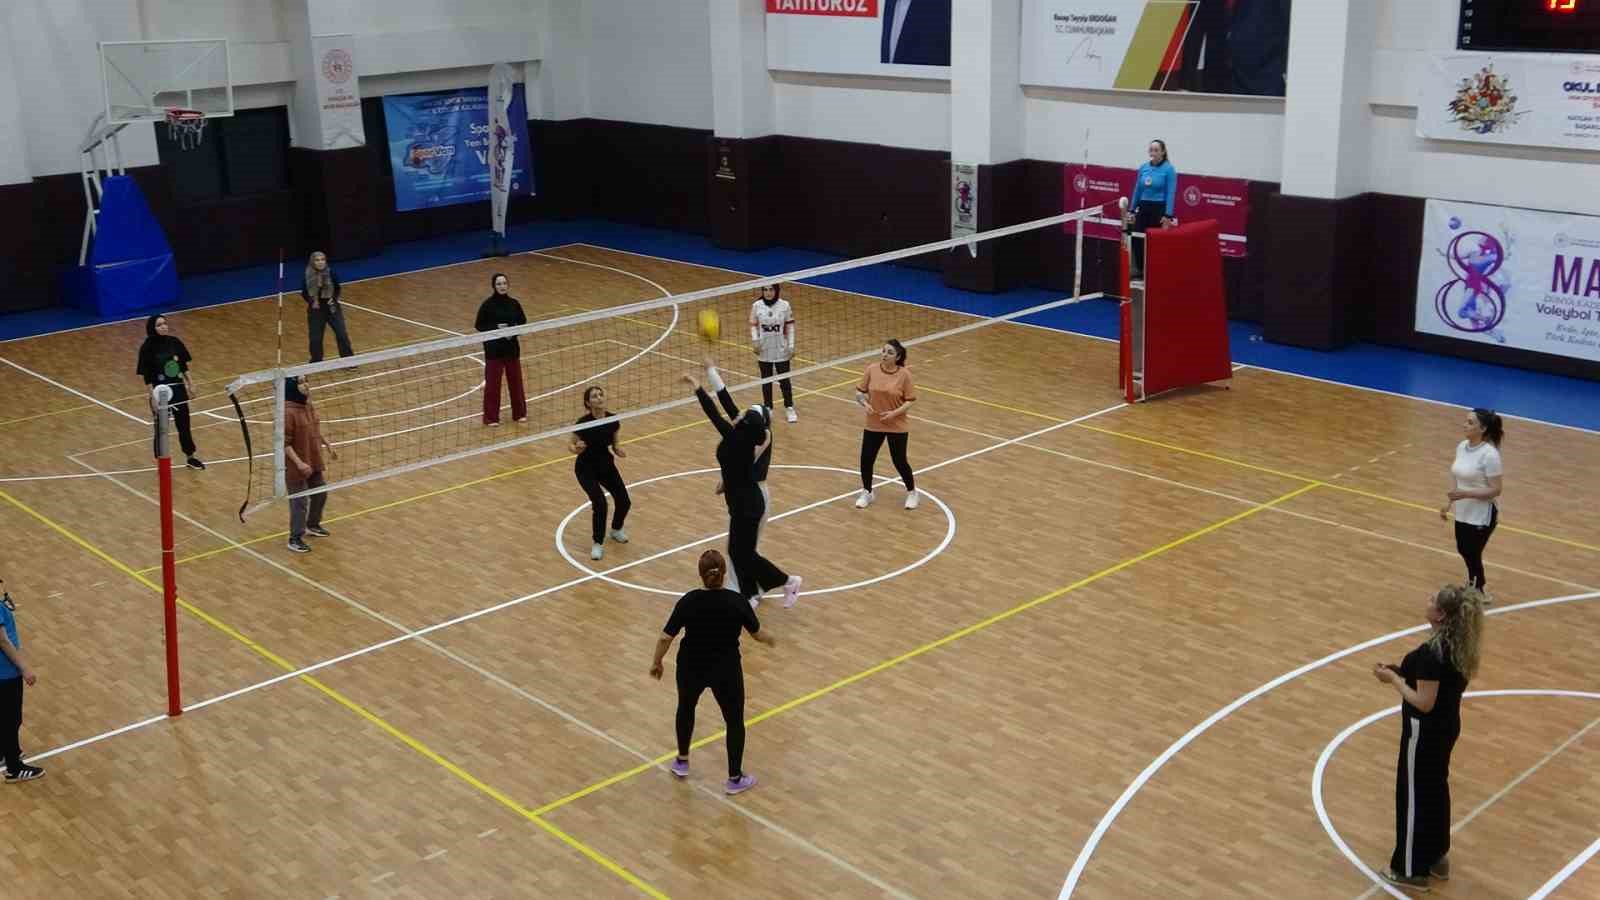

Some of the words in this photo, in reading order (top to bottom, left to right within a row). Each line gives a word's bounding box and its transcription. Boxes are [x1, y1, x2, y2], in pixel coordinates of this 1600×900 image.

[1563, 81, 1595, 93] OKUL
[1552, 253, 1600, 298] MA
[1536, 302, 1591, 320] Voleybol
